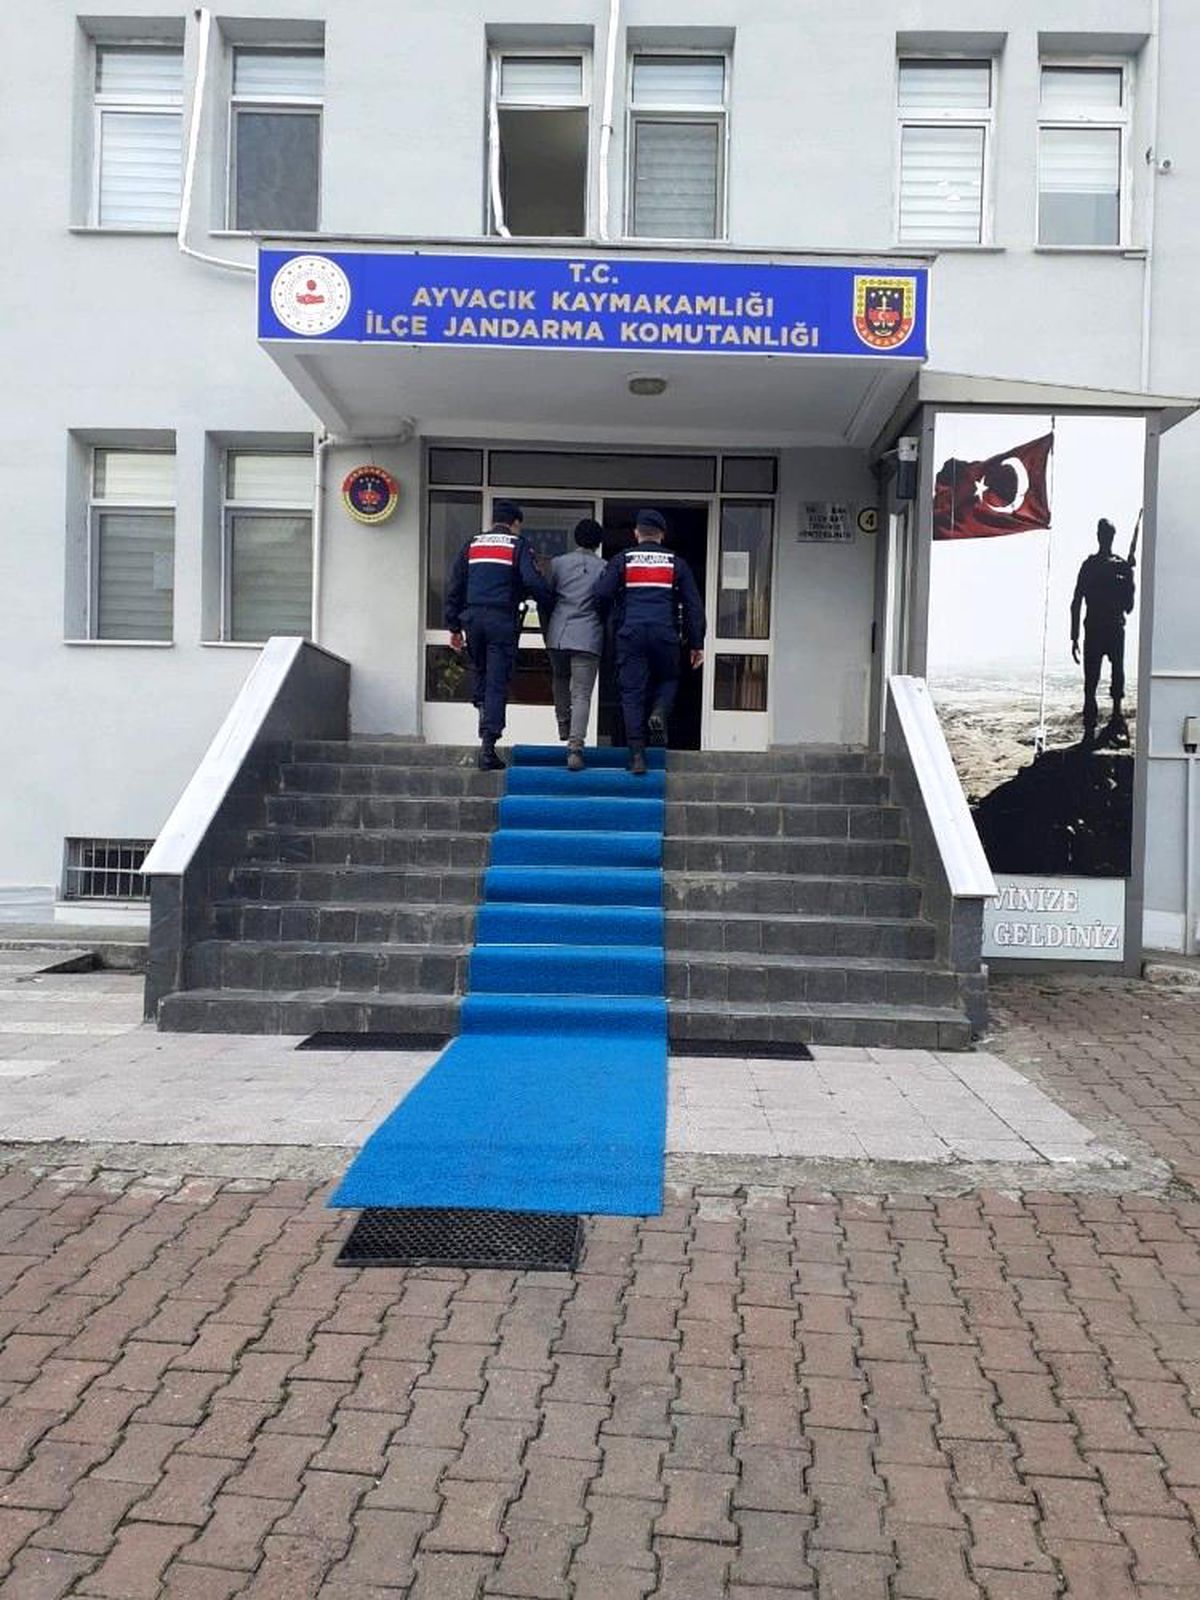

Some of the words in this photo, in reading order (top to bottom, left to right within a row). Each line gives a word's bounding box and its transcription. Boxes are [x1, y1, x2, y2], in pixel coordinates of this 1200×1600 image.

[568, 263, 619, 284] T.C.
[411, 287, 536, 310] AYVACIK
[551, 291, 774, 318] KAYMAKAMLIĞI
[366, 309, 428, 337] İLÇE
[443, 316, 604, 341] JANDARMA
[620, 321, 819, 347] KOMUTANLIĞI
[984, 883, 1078, 912] VİNİZE
[993, 919, 1119, 949] GELDİNİZ
